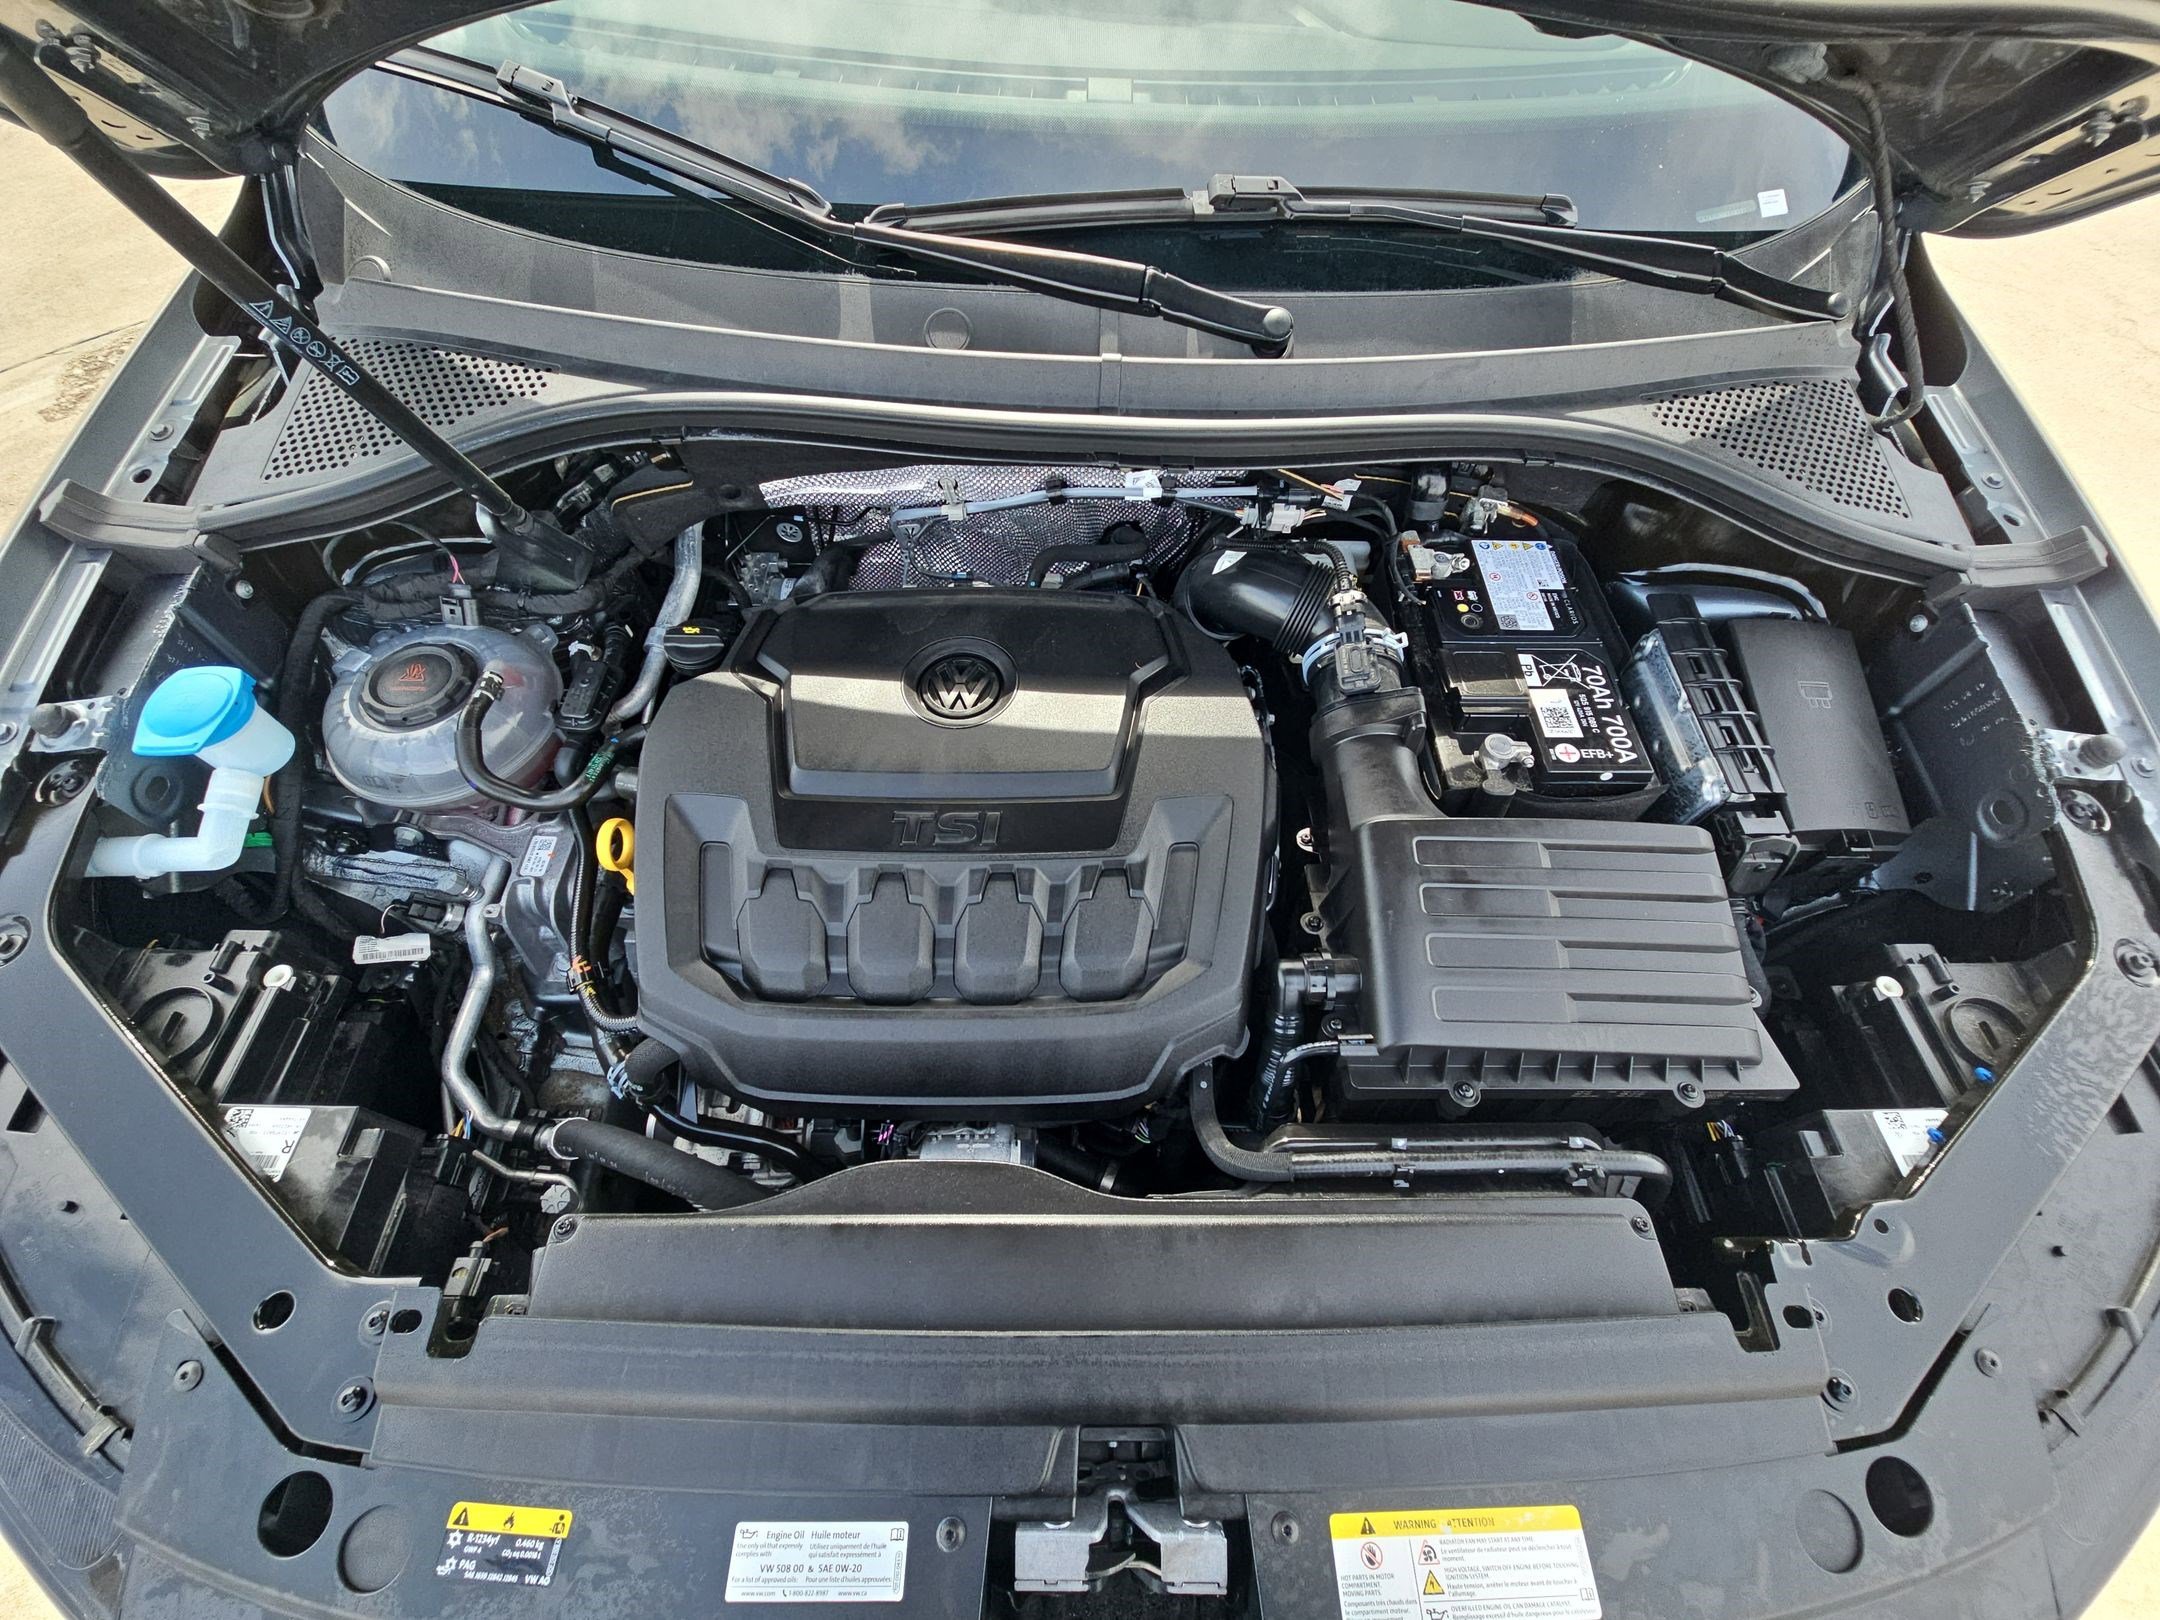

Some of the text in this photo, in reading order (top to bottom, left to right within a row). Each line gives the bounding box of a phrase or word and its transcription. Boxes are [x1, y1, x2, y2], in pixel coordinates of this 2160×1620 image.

[1564, 600, 1579, 624] CLARIOS
[1521, 664, 1533, 677] Pb
[1582, 666, 1638, 764] 70Ah 700A
[1580, 748, 1614, 758] EFB+
[891, 810, 1003, 846] TSI
[282, 1140, 296, 1154] R
[1393, 1520, 1437, 1530] WARNING
[466, 1532, 501, 1548] R-1234yf
[766, 1530, 805, 1542] Engine Oil
[810, 1530, 861, 1540] Huile moteur
[515, 1538, 545, 1552] 0.460 kg
[747, 1542, 759, 1550] only
[736, 1551, 759, 1559] complies
[458, 1558, 476, 1570] PAG
[760, 1564, 862, 1574] VW 508 00 & SAE 0W-20
[525, 1574, 550, 1586] VW AG
[761, 1576, 786, 1584] approved
[1376, 1572, 1394, 1580] MOTOR
[1344, 1600, 1375, 1608] Composants
[1351, 1608, 1390, 1616] compartiment
